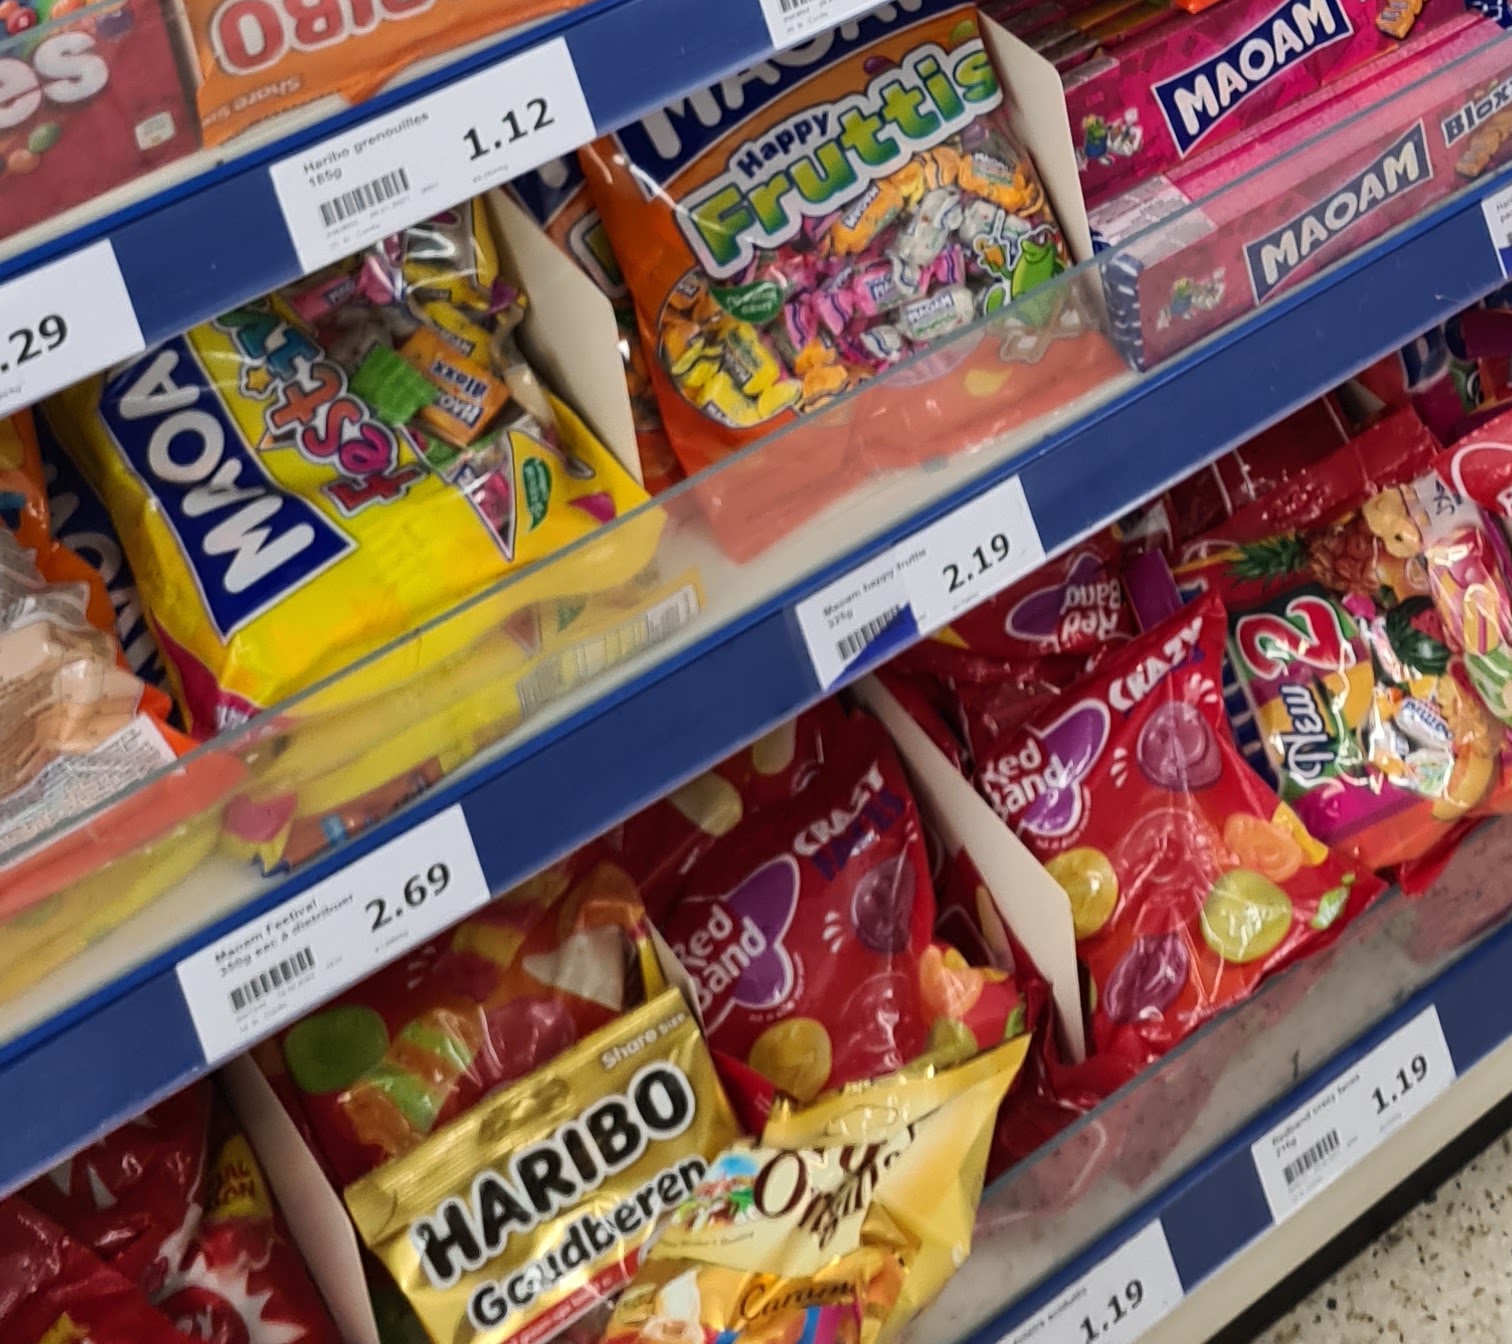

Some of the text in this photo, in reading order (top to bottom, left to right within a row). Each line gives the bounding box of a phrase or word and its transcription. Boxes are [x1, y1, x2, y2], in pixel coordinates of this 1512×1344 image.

[303, 111, 430, 175] Haribo grenouilles
[463, 96, 556, 161] 1.12
[686, 42, 1004, 277] Fruttis
[737, 106, 834, 181] Happy
[307, 165, 343, 189] 185g
[1263, 138, 1423, 286] MAOAM
[942, 532, 1010, 593] 2.19
[1108, 614, 1204, 713] CRAZY
[365, 861, 451, 934] 2.69
[600, 1025, 658, 1072] Share
[1371, 1053, 1428, 1115] 1.19
[411, 1062, 694, 1286] HARIBO
[1079, 1278, 1144, 1344] 1.19
